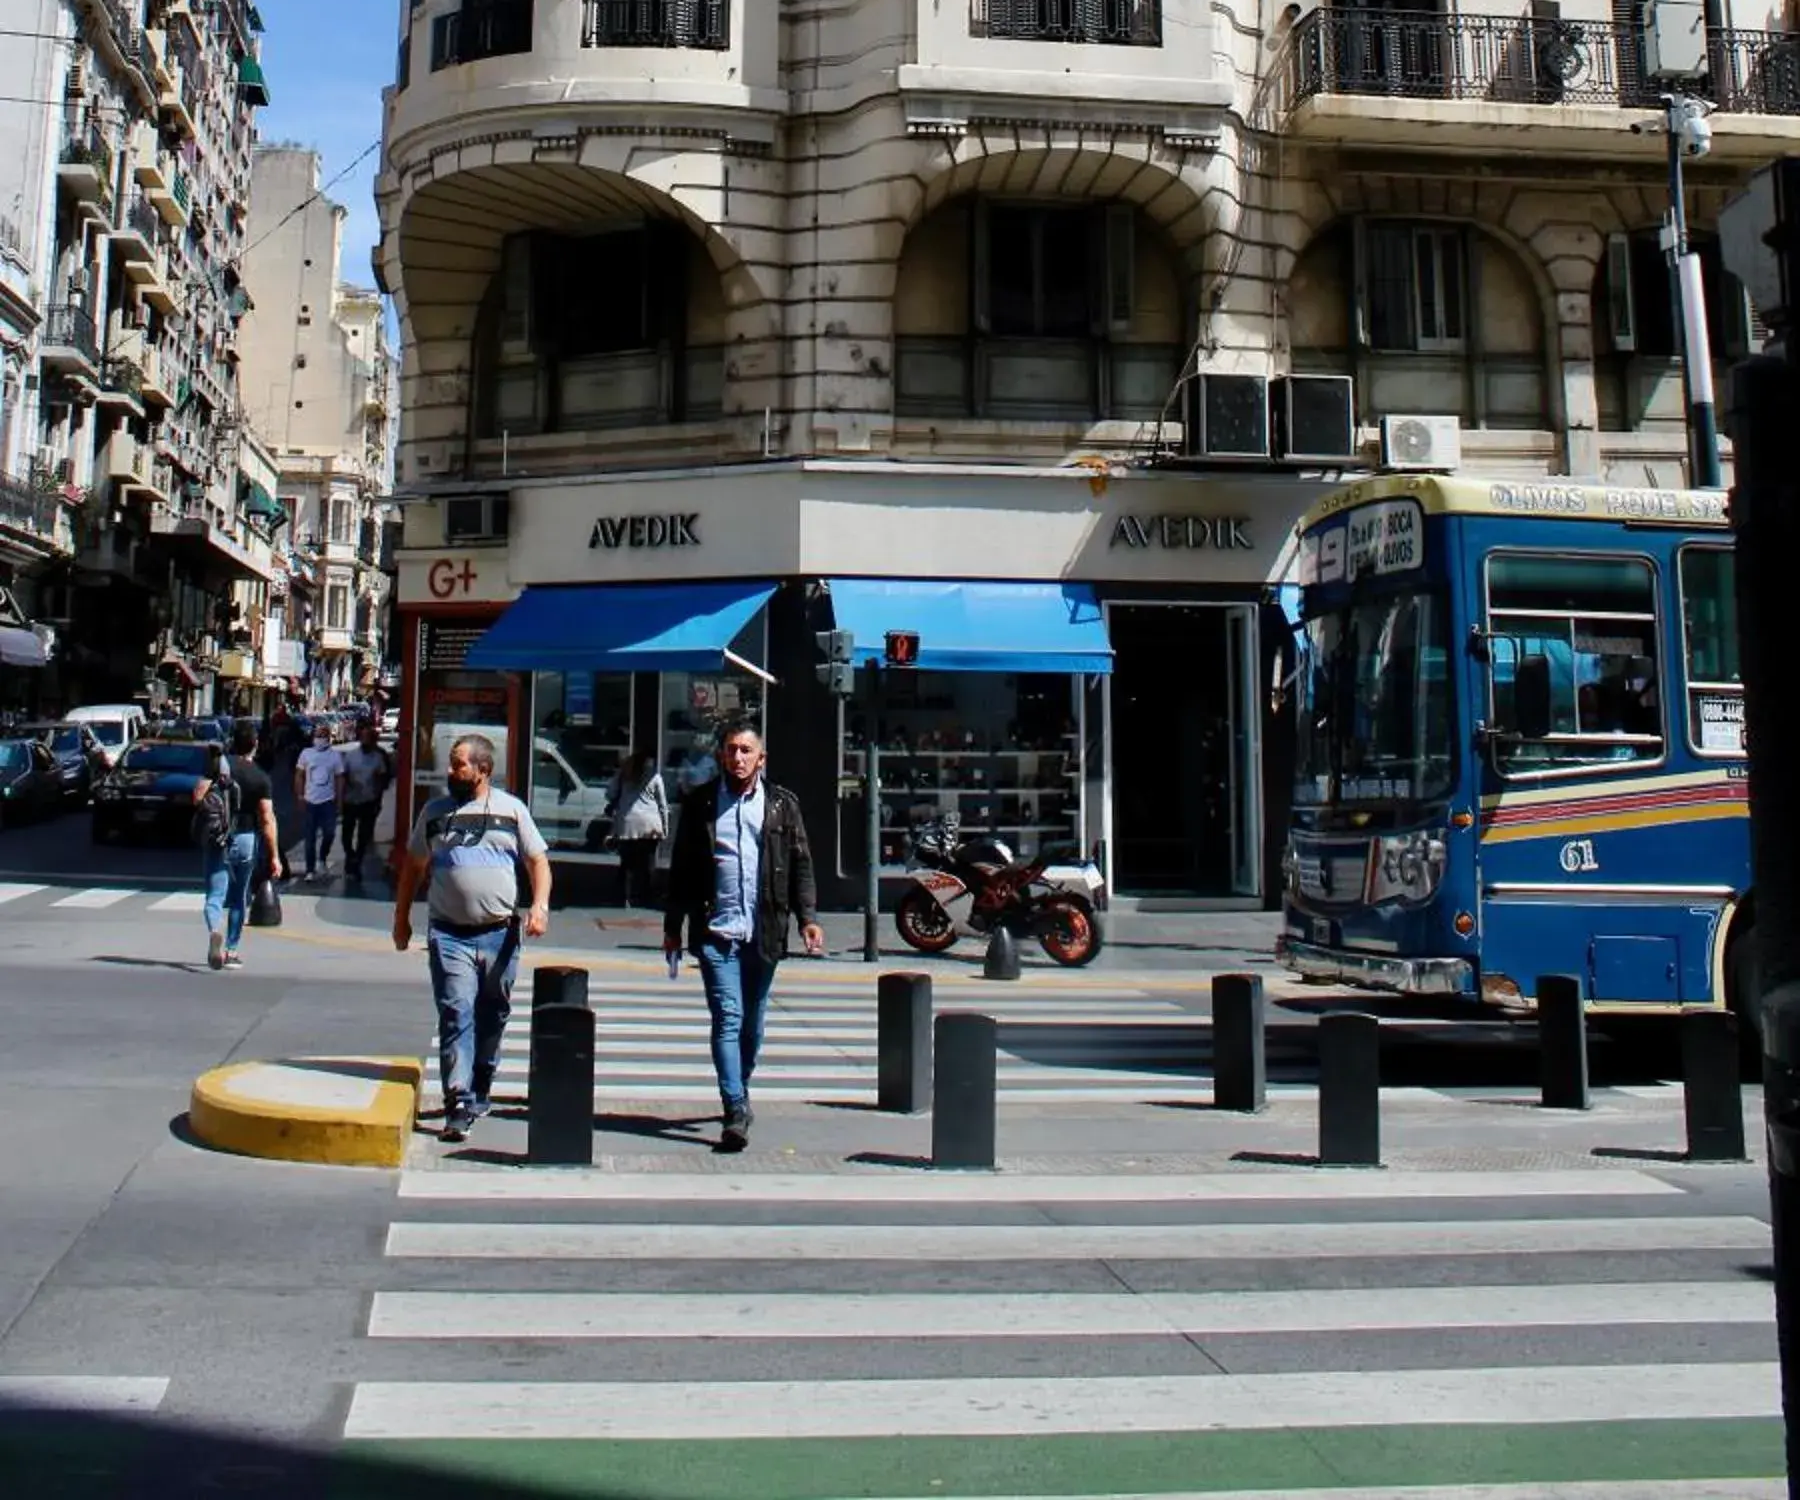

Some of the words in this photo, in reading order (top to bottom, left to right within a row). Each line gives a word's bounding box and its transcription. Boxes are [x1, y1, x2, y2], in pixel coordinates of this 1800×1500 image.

[1490, 483, 1587, 513] OLIVOS
[588, 512, 702, 549] AVEDIK
[1109, 514, 1255, 550] AVEDIK
[428, 558, 478, 598] G+
[1560, 839, 1599, 873] 61
